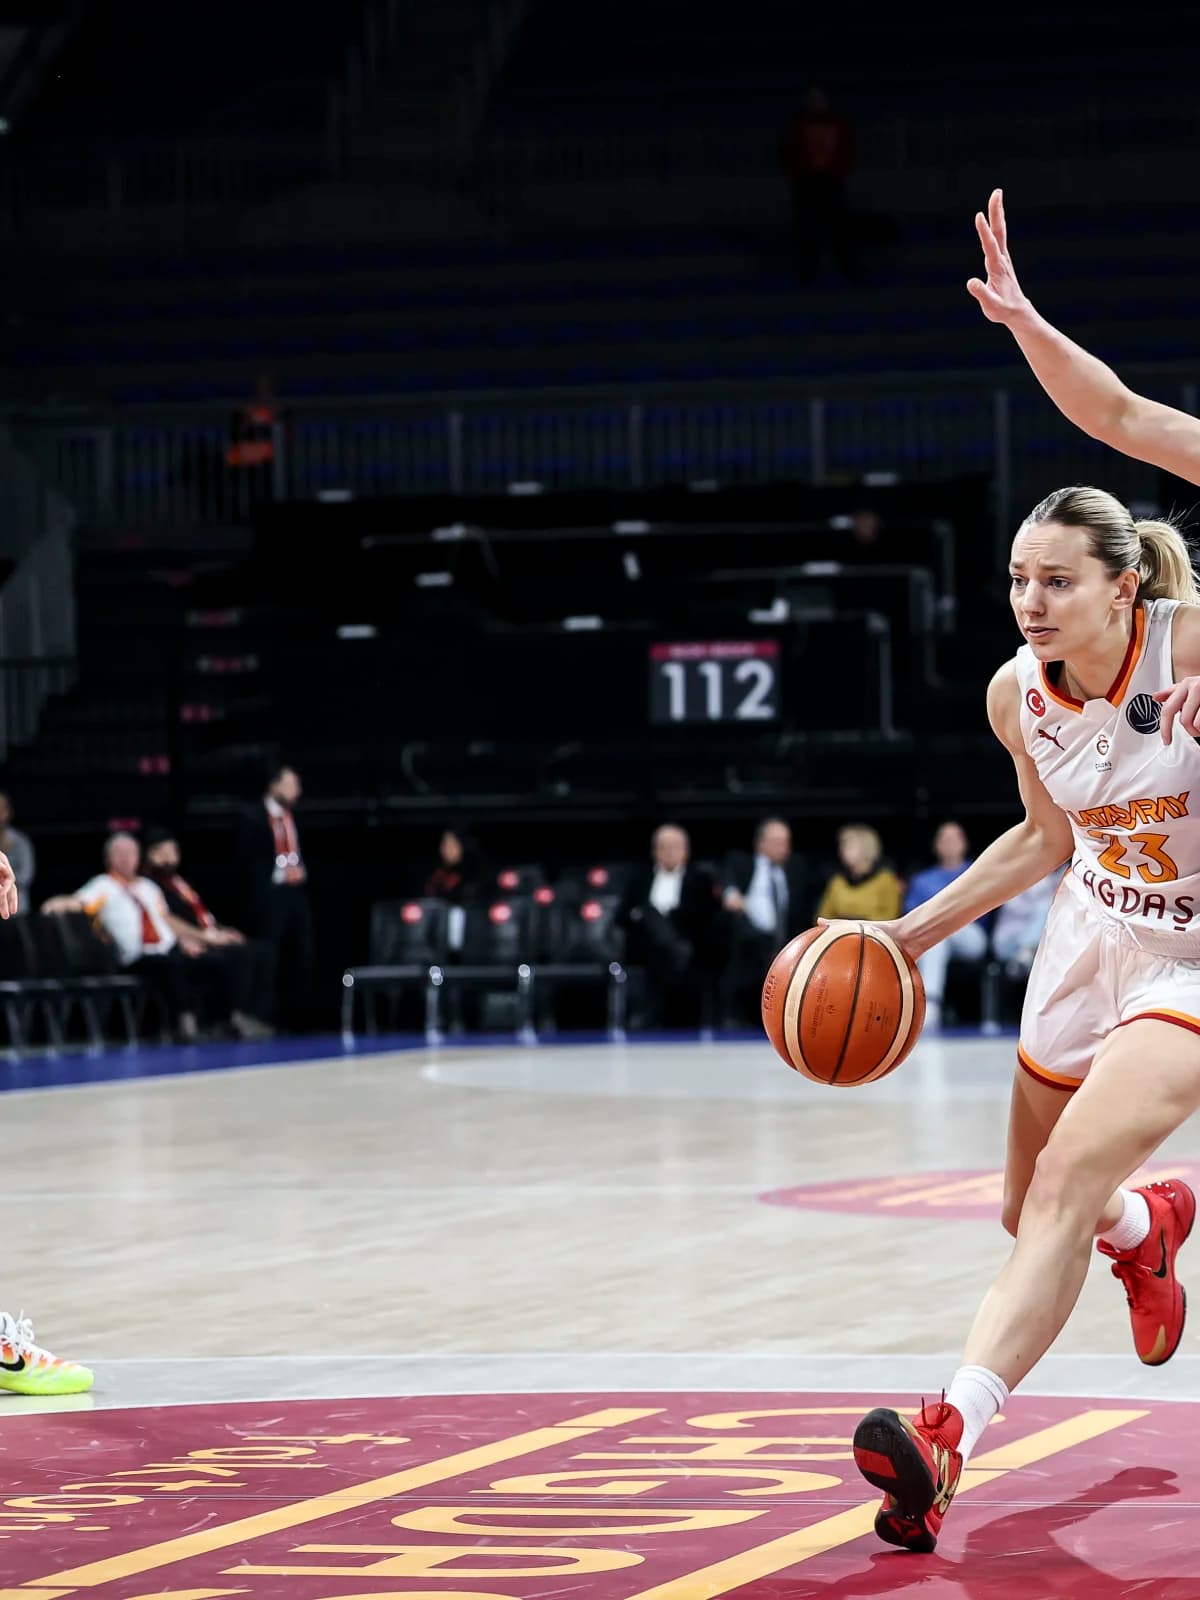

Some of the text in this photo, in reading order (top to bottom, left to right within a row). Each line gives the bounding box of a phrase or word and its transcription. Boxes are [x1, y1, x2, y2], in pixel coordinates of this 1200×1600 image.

[661, 659, 774, 721] 112
[1087, 829, 1179, 884] 23
[0, 1431, 412, 1539] faktori
